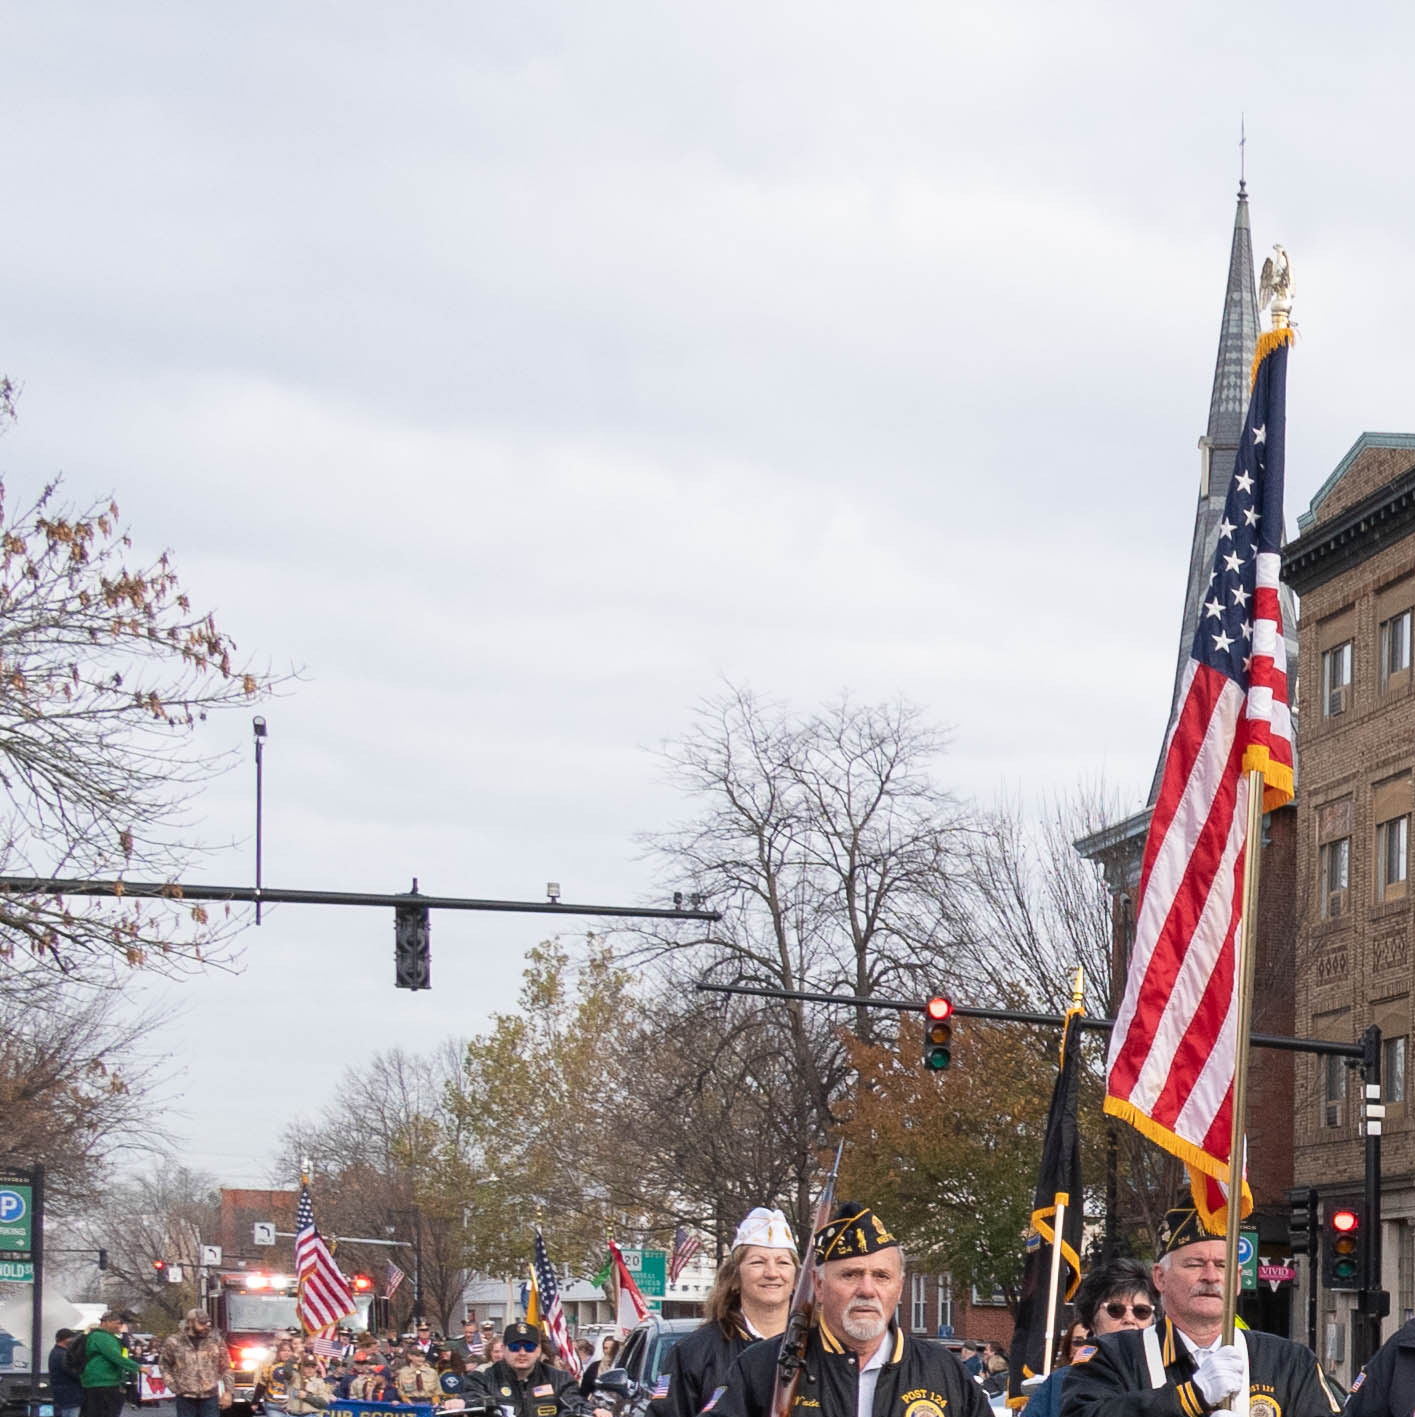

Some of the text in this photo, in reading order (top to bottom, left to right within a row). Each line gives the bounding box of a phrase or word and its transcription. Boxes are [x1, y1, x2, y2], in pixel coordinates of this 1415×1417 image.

[1261, 1266, 1289, 1276] VIVID
[901, 1388, 948, 1408] POST 124
